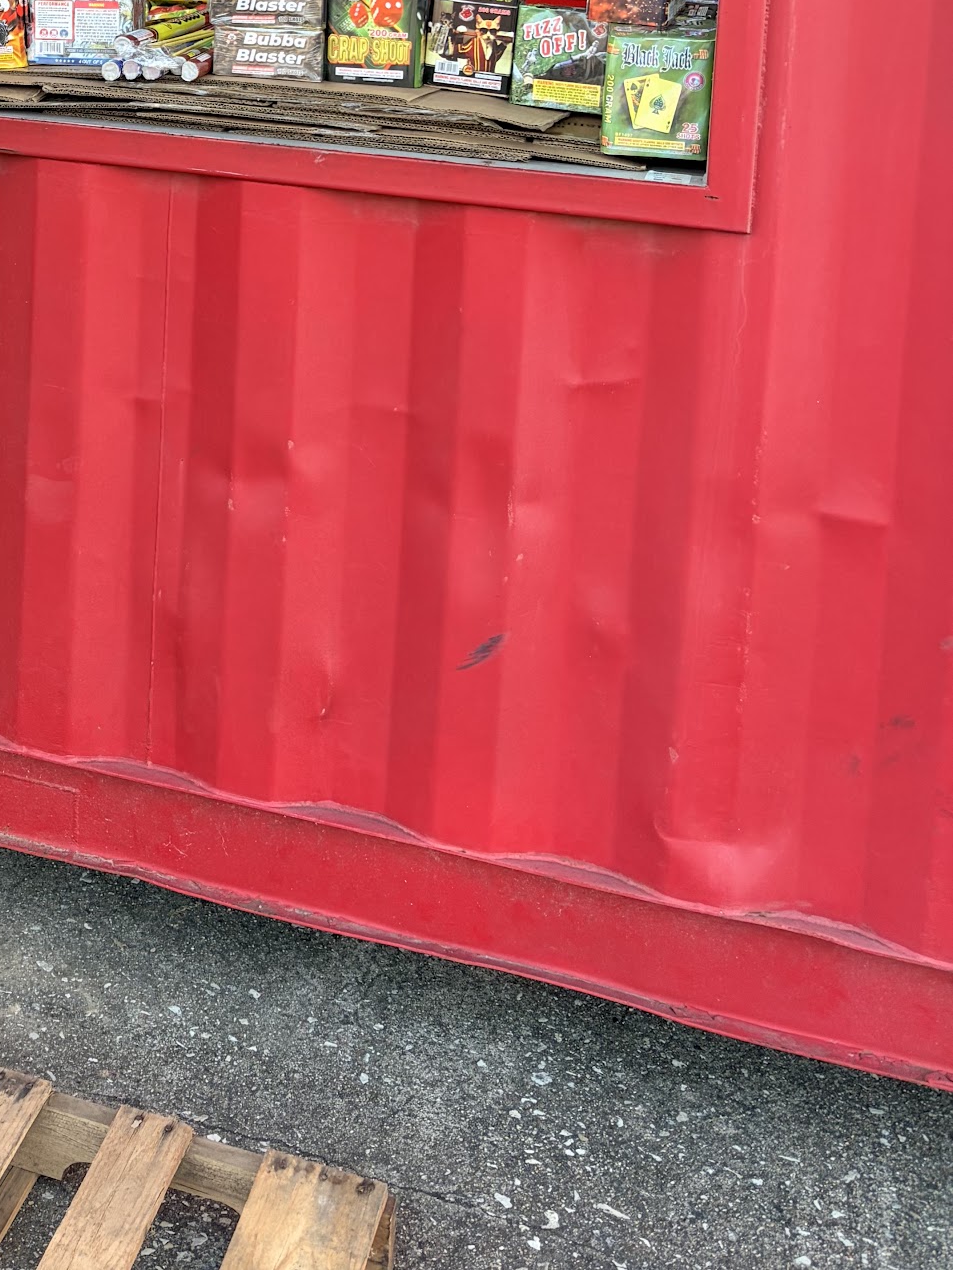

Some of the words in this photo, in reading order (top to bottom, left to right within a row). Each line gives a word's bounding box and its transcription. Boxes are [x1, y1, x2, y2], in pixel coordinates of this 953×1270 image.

[370, 29, 387, 37] 200
[523, 15, 564, 40] FIZZ
[243, 32, 307, 48] Bubba
[328, 35, 368, 64] CRAP
[371, 39, 412, 66] SHOOT
[539, 30, 587, 58] OFF!
[235, 49, 306, 65] Blaster
[621, 42, 659, 70] Black
[660, 45, 692, 72] Jack
[606, 75, 614, 95] 200
[604, 96, 614, 123] GRAM
[682, 122, 699, 133] 25
